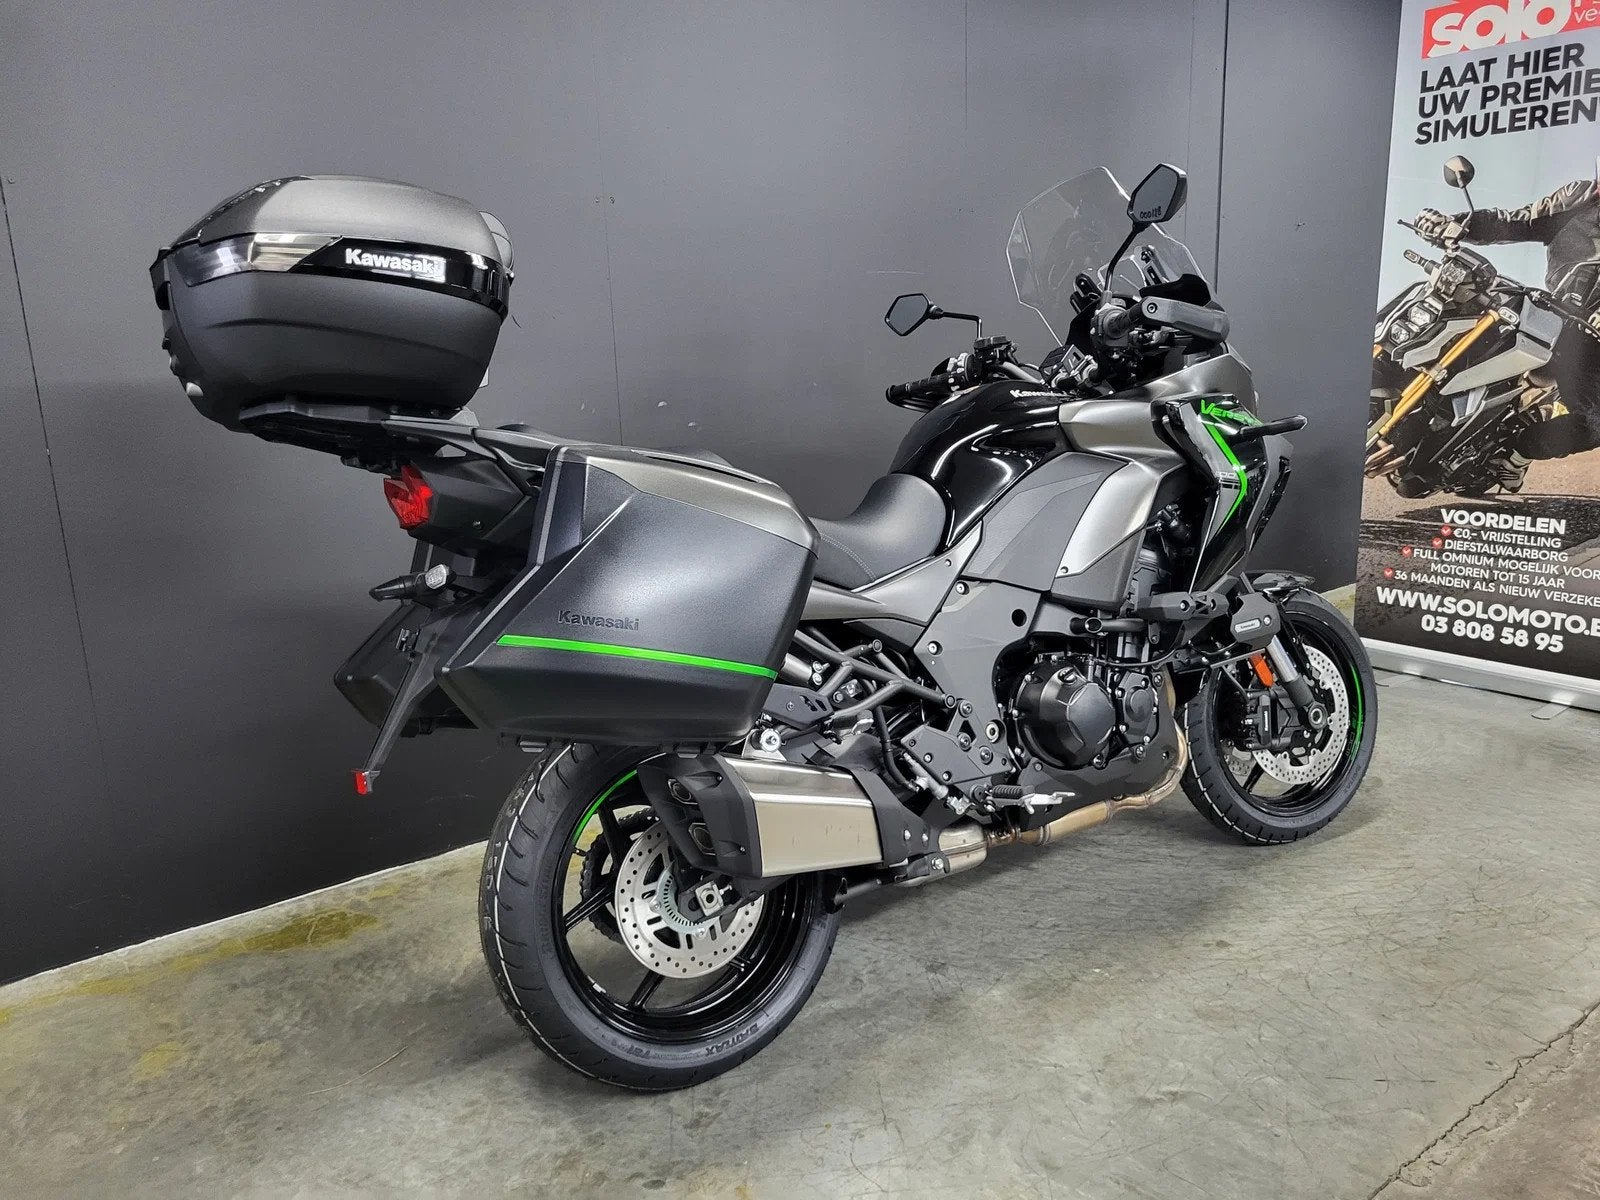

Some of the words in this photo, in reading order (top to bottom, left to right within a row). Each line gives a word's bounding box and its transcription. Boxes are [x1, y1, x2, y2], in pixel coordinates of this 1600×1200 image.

[1574, 8, 1600, 24] ve
[1420, 57, 1498, 94] LAAT
[1506, 42, 1585, 79] HIER
[1418, 89, 1470, 119] UW
[1414, 97, 1600, 145] SIMULEREN
[1440, 508, 1567, 535] VOORDELEN
[1444, 539, 1569, 562] DIEFSTALWAARBORG
[1480, 530, 1562, 549] VRIJSTELLING
[1413, 549, 1439, 561] FULL
[1442, 551, 1494, 567] OMNIUM
[1498, 559, 1560, 575] MOGELIJK
[1563, 565, 1600, 580] VOOR
[1430, 562, 1490, 579] MOTOREN
[1493, 570, 1516, 583] TOT
[1518, 574, 1530, 585] 15
[1533, 575, 1565, 589] JAAR
[1394, 570, 1407, 581] 36
[1410, 572, 1470, 590] MAANDEN
[1473, 580, 1496, 593] ALS
[1499, 584, 1541, 599] NIEUW
[558, 610, 640, 631] Kawasaki
[1421, 614, 1448, 634] 03
[1452, 619, 1495, 642] 808
[1499, 627, 1529, 648] 58
[1534, 632, 1564, 653] 95
